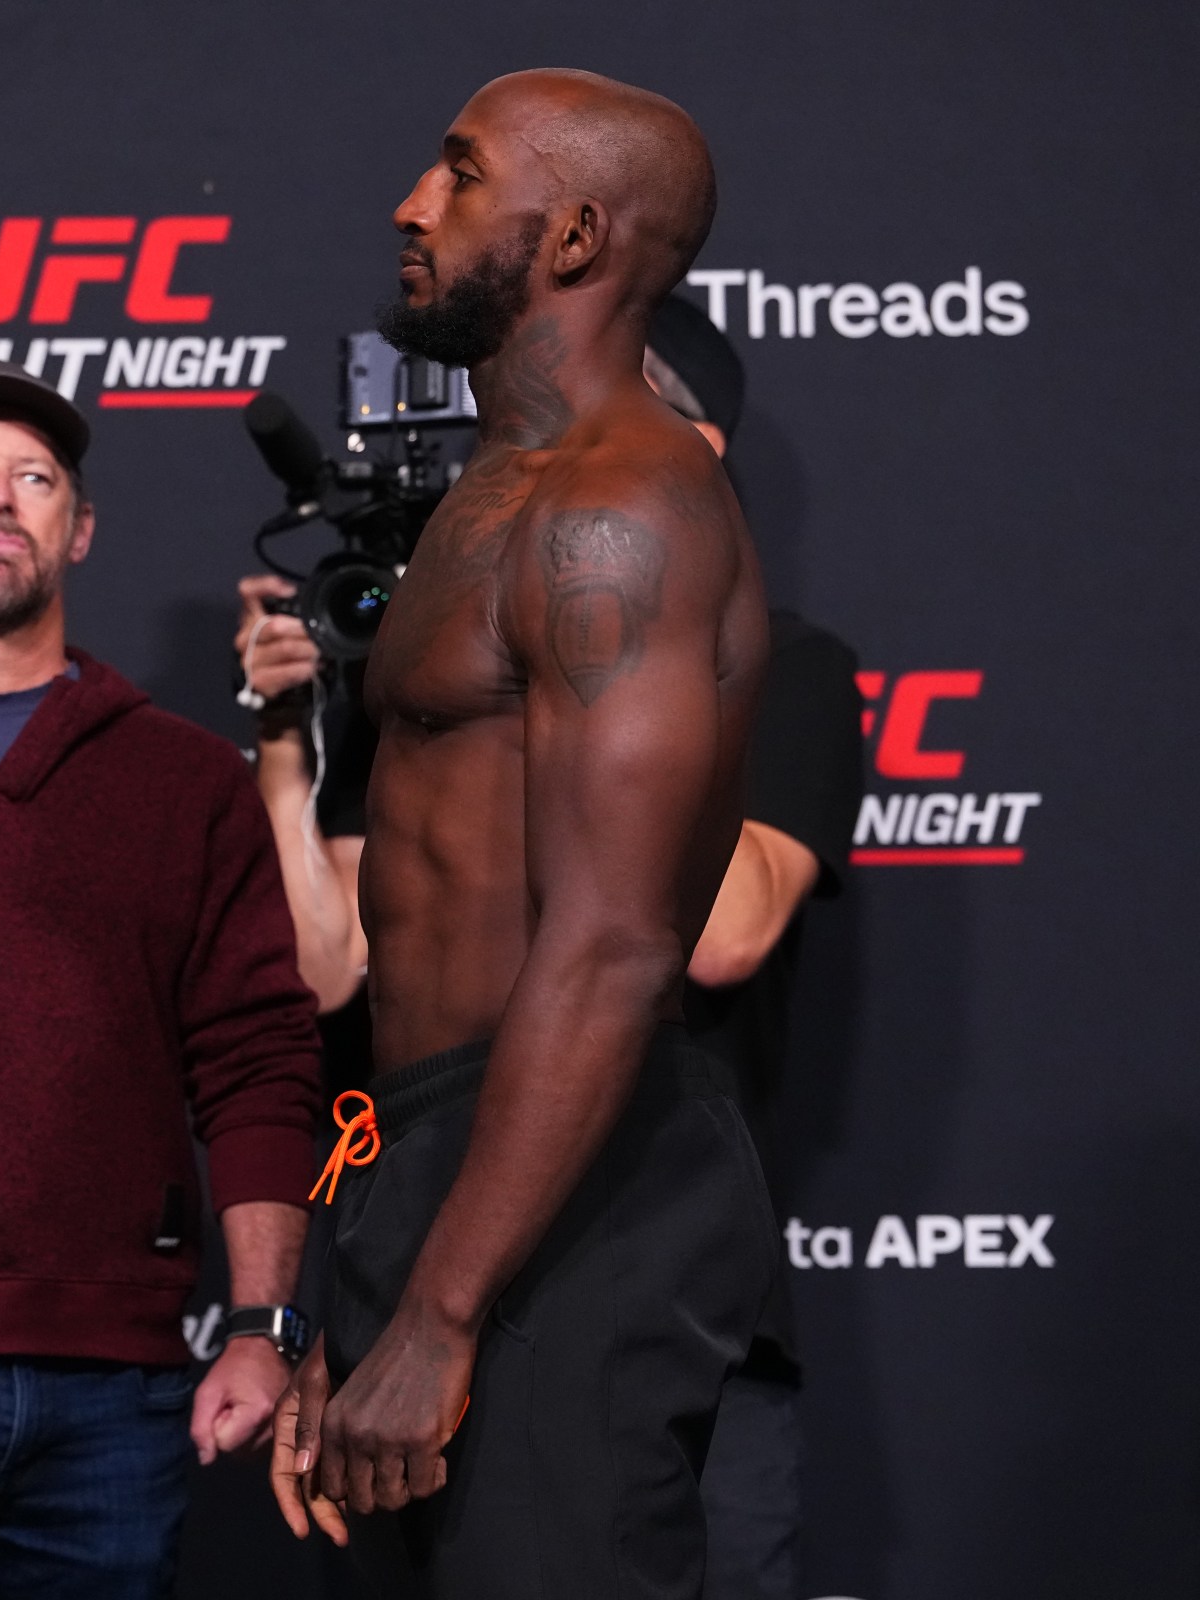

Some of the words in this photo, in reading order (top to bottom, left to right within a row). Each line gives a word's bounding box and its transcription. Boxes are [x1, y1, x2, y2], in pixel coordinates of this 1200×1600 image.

[686, 265, 1031, 339] Threads
[103, 336, 287, 388] NIGHT
[852, 792, 1042, 845] NIGHT
[783, 1215, 853, 1269] ta
[864, 1214, 1056, 1269] APEX
